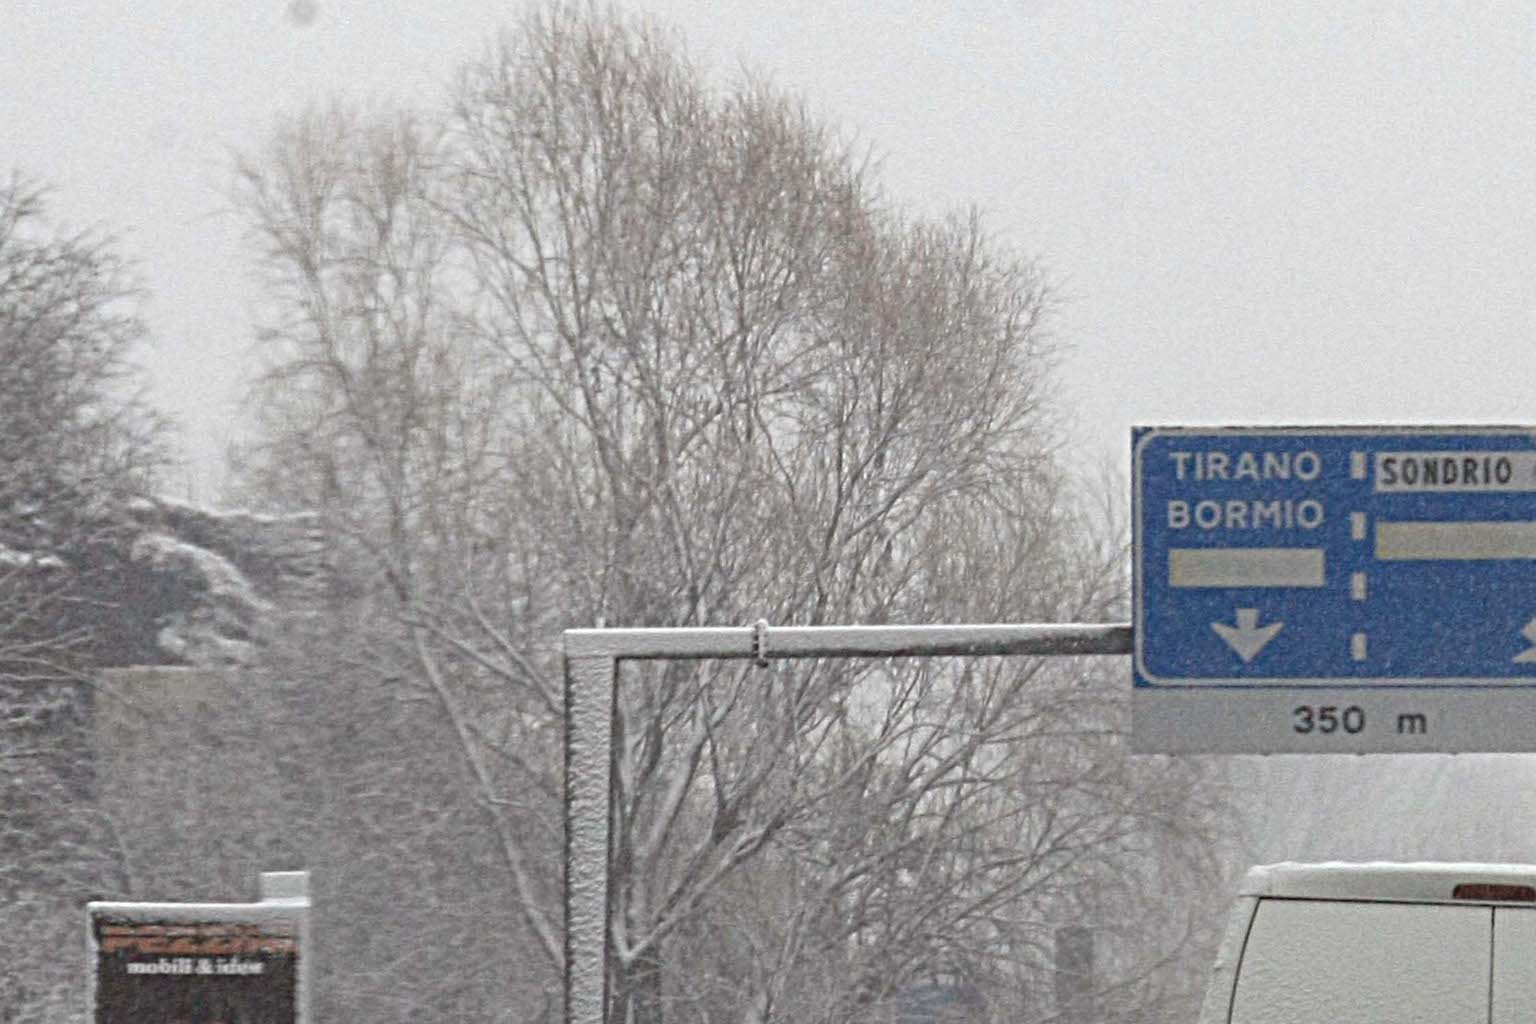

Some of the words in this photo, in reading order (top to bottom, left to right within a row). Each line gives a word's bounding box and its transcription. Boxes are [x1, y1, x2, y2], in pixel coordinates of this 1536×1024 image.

[1169, 451, 1322, 481] TIRANO
[1381, 456, 1513, 486] SONDRIO
[1167, 500, 1325, 529] BORMIO
[1293, 705, 1366, 735] 350
[1397, 711, 1427, 735] m
